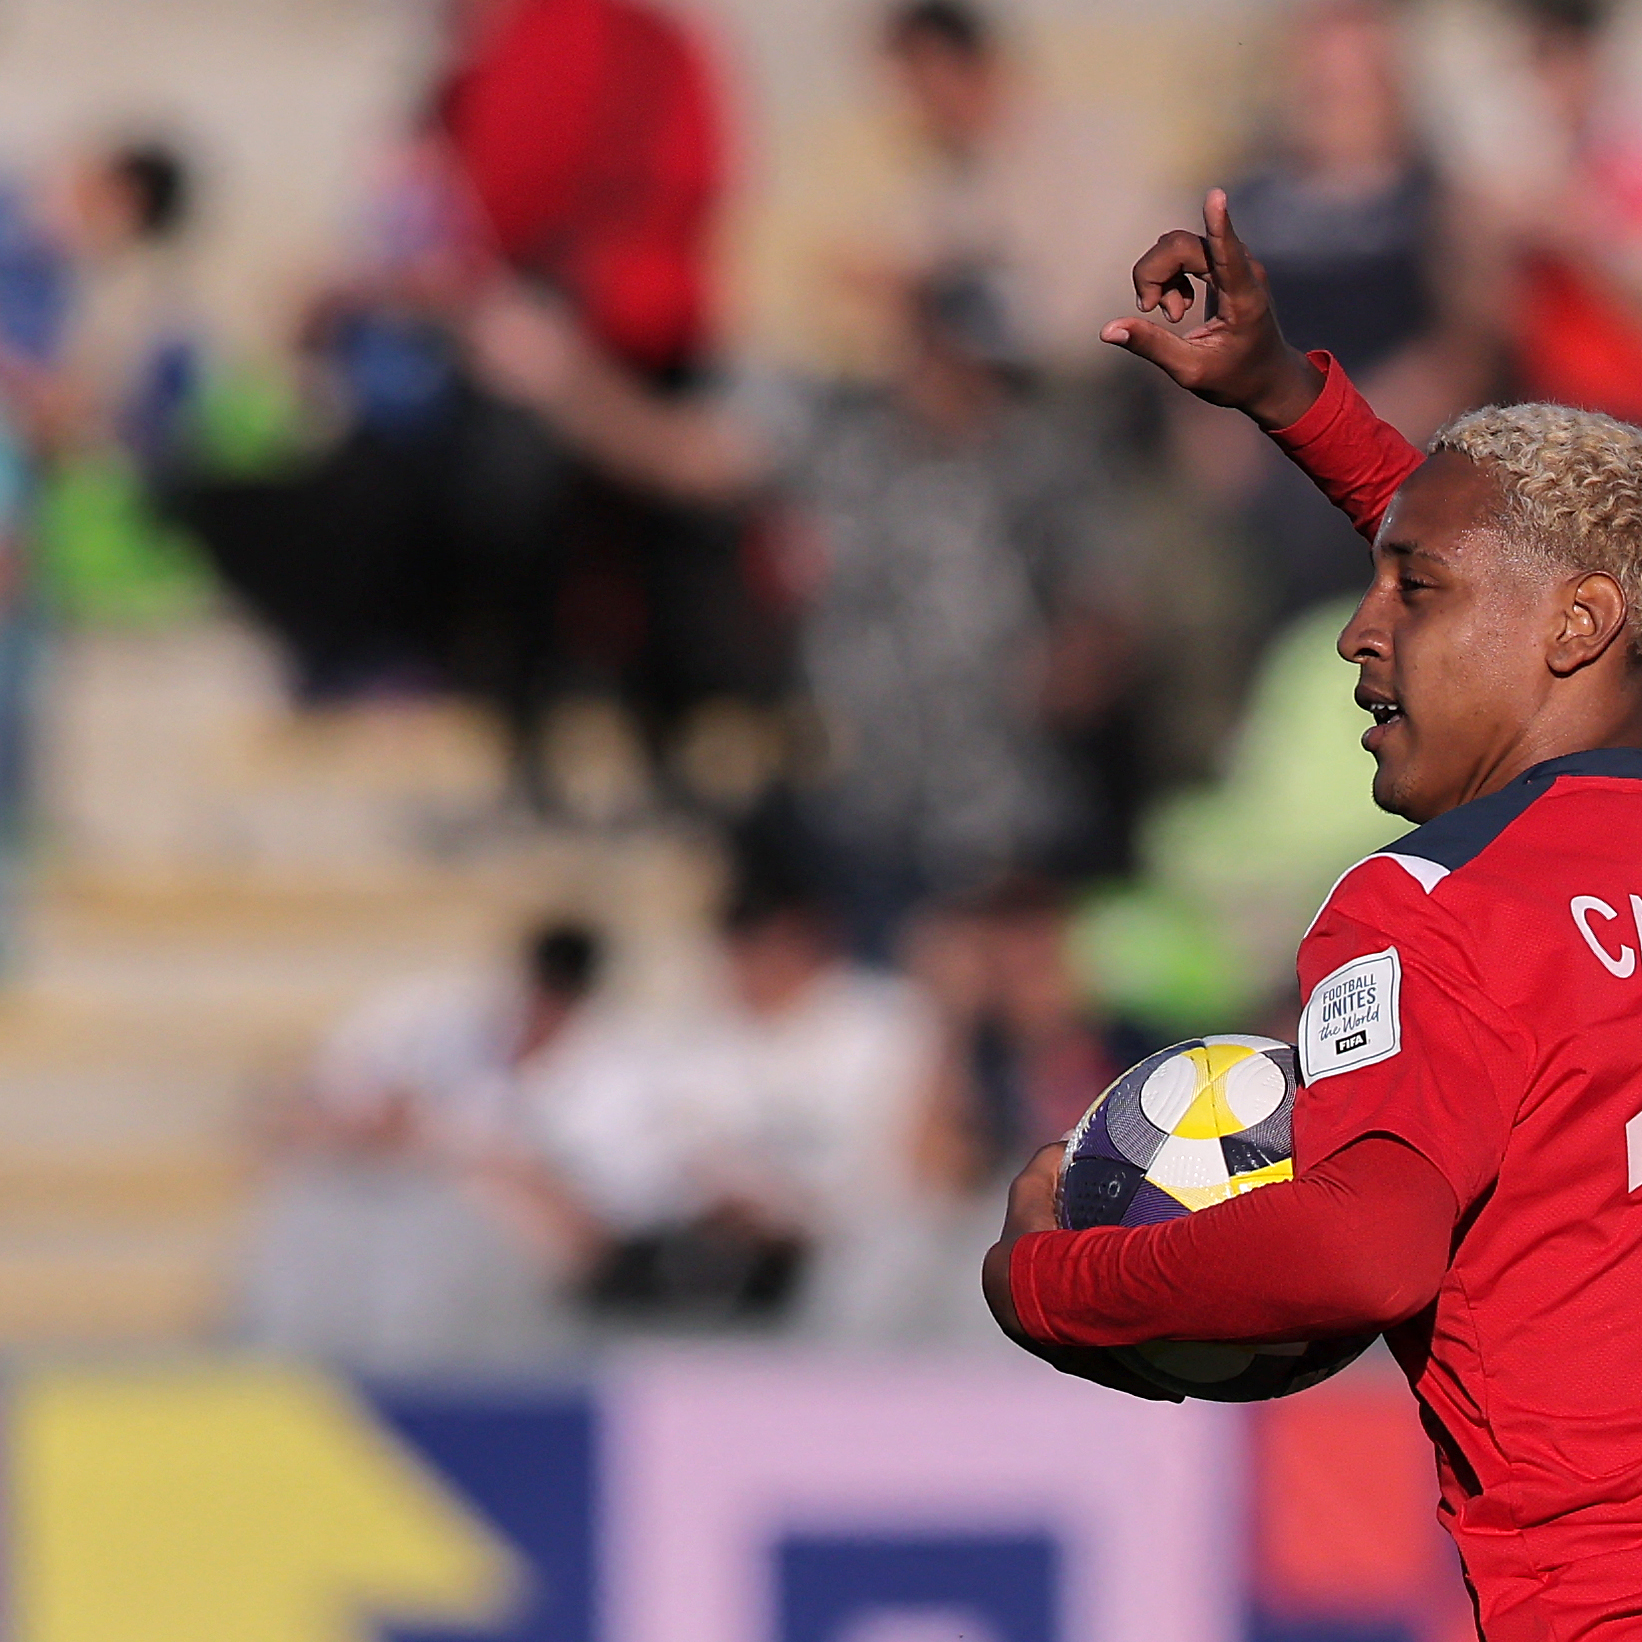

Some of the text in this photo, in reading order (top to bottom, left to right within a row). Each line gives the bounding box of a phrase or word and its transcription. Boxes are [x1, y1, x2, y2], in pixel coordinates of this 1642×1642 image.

[1322, 973, 1377, 1004] FOOTBALL
[1322, 986, 1377, 1022] UNITES
[1318, 1003, 1381, 1041] the World
[1339, 1034, 1364, 1051] FIFA
